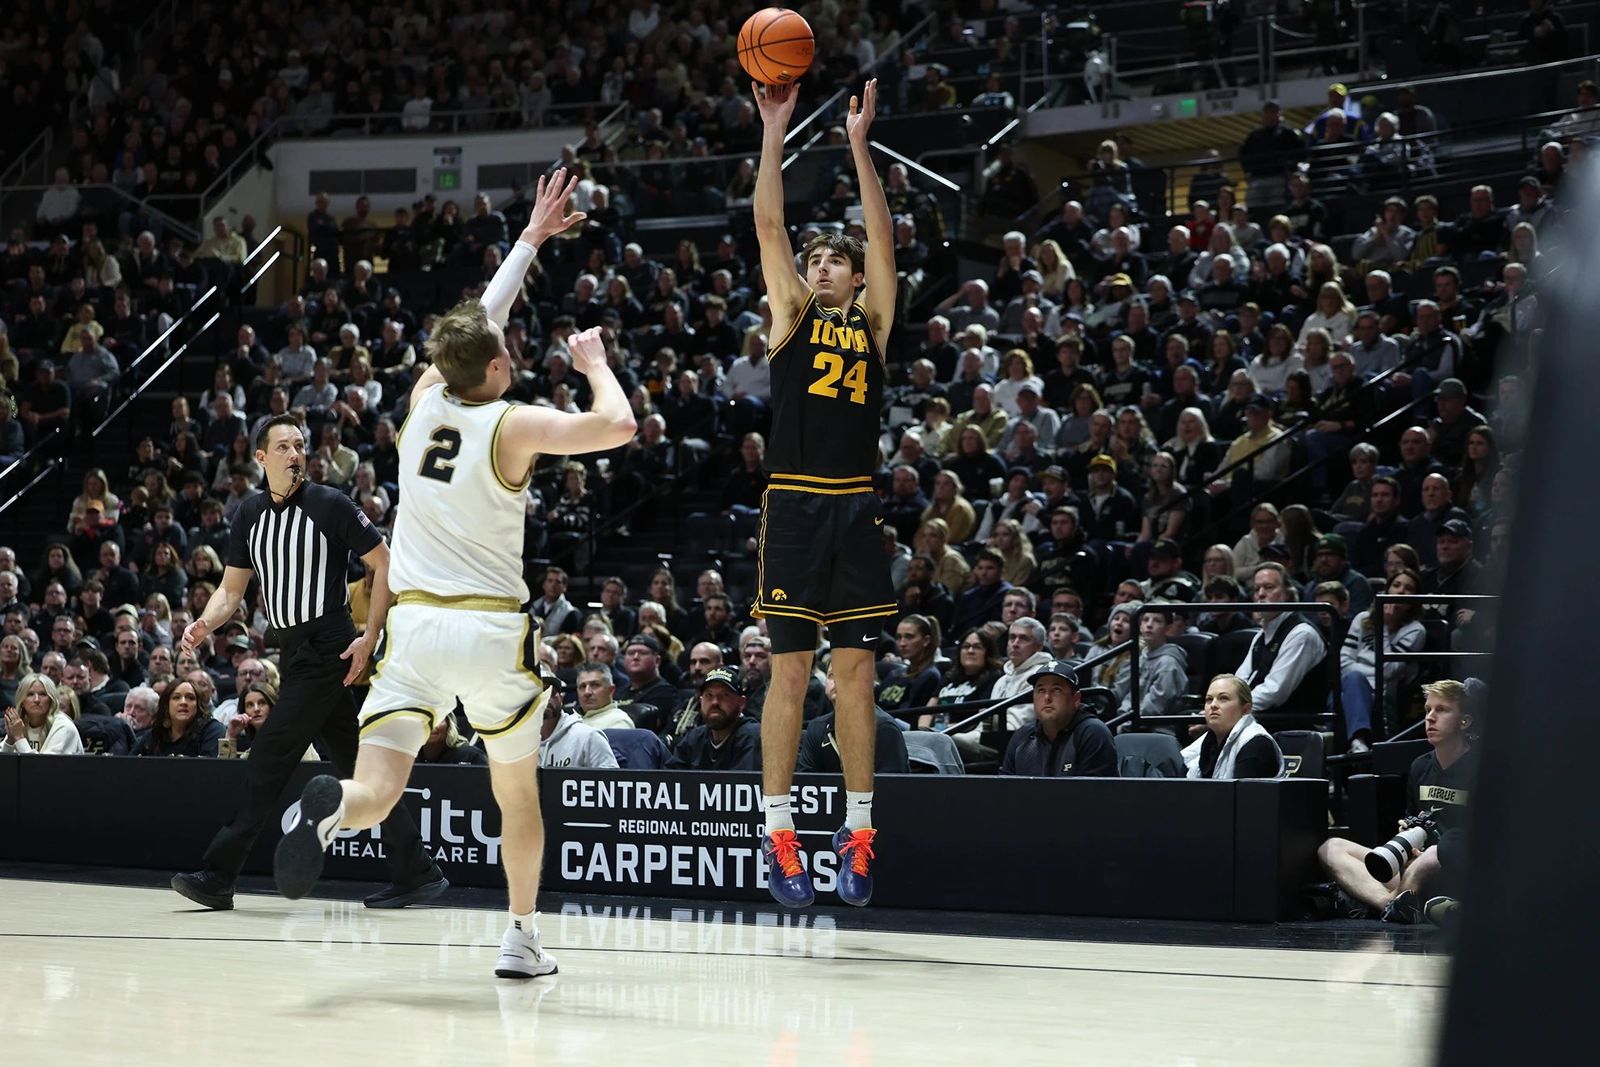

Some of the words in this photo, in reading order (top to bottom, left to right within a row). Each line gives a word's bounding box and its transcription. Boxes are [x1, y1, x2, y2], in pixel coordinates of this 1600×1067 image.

[809, 318, 870, 354] IOWA
[807, 351, 868, 405] 24
[416, 423, 463, 485] 2
[562, 779, 690, 811] CENTRAL
[699, 783, 838, 815] MIDEST
[618, 819, 688, 836] REGIONAL
[691, 821, 752, 838] COUNCIL
